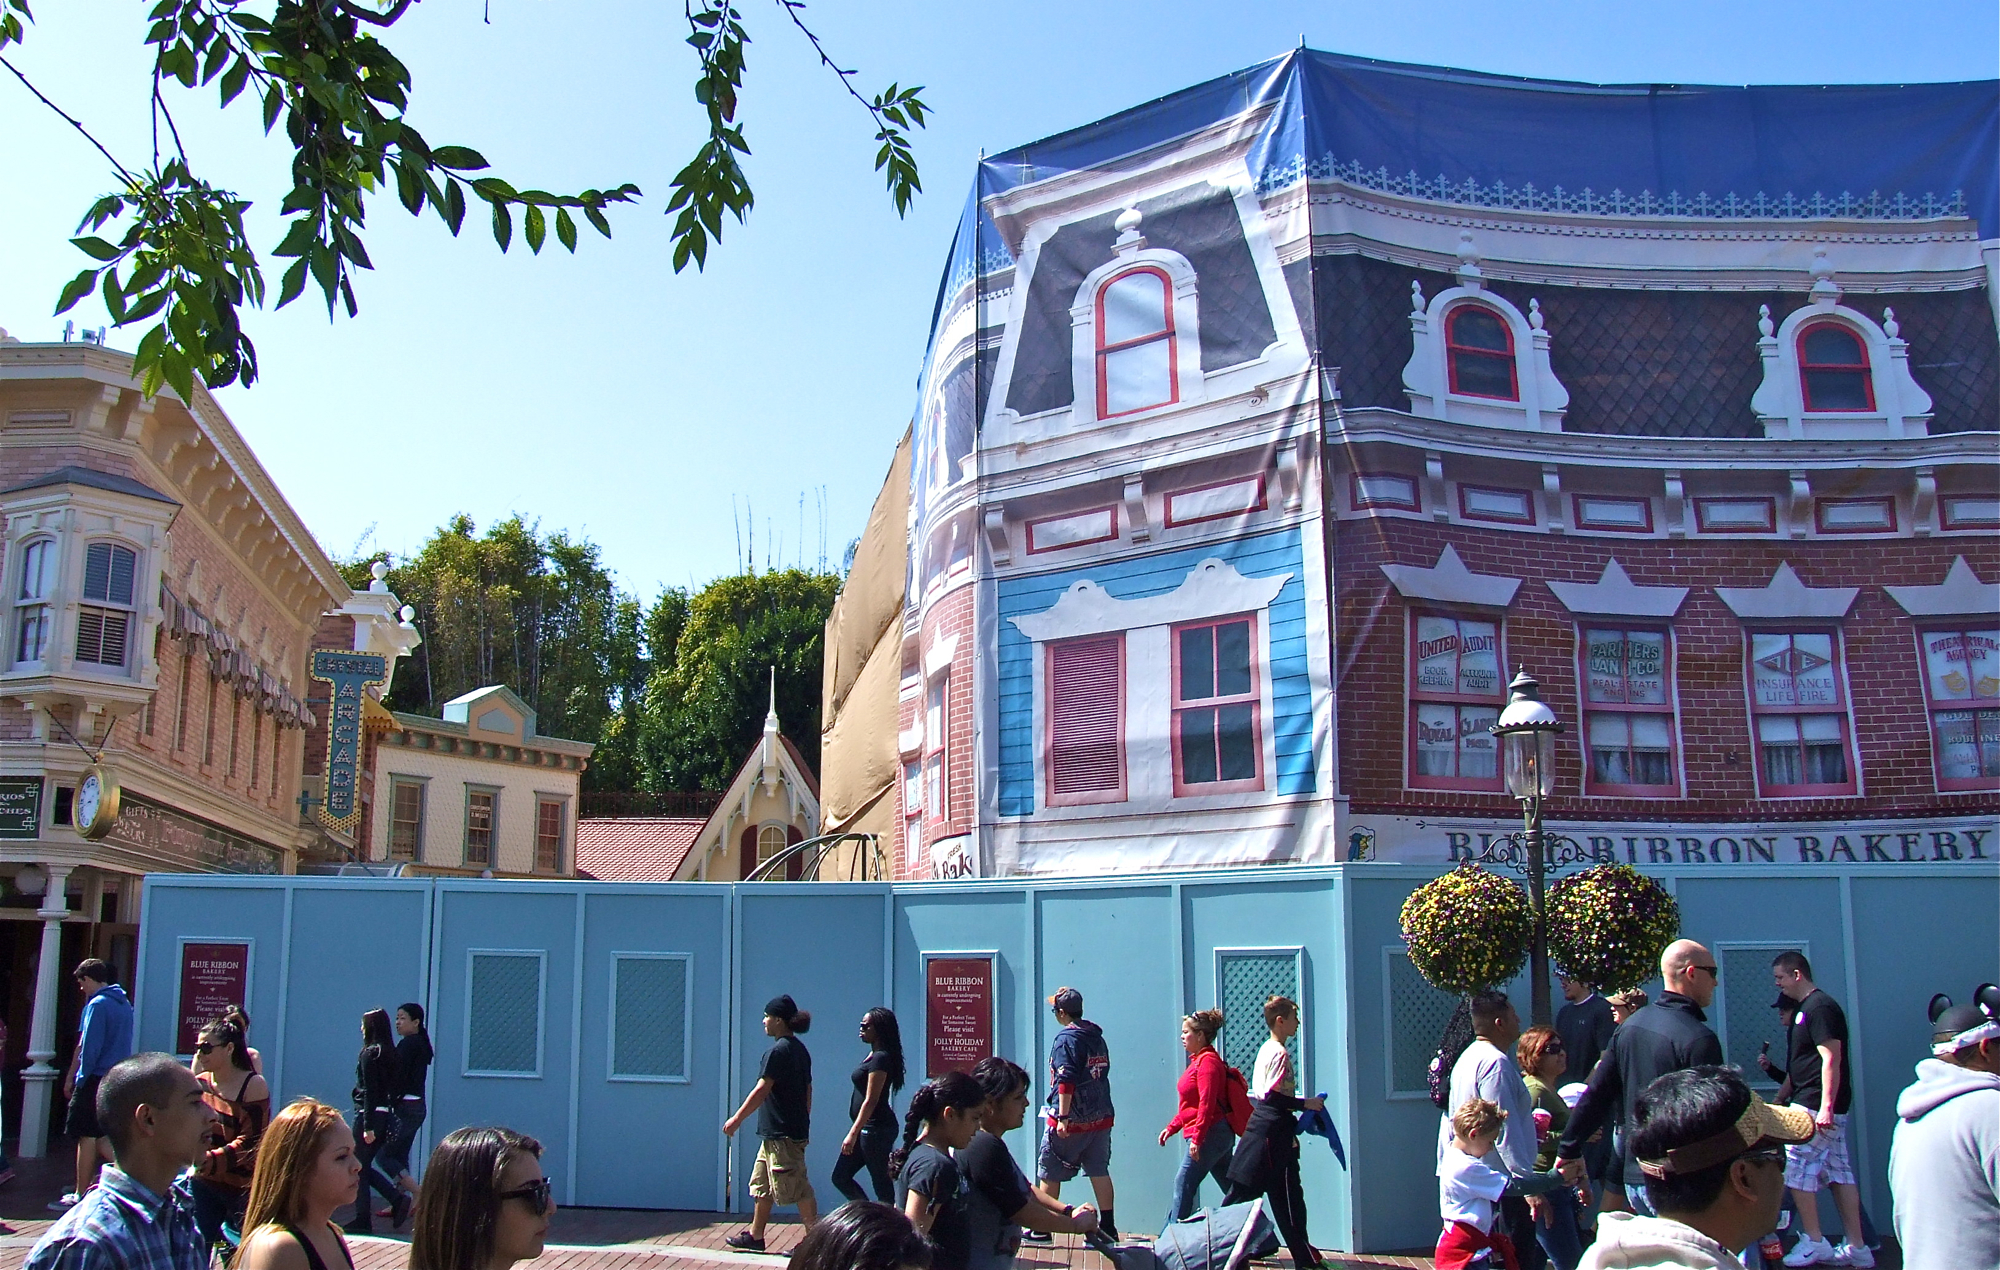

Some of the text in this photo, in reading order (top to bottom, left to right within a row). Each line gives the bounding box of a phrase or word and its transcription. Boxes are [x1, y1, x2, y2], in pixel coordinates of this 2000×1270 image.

[1418, 634, 1494, 660] UNITED AUDIT
[1591, 640, 1659, 660] FARMERS
[317, 657, 383, 676] CRYSTAL
[1425, 666, 1447, 676] BOOK
[1418, 675, 1453, 686] KEEPING
[1757, 678, 1832, 690] INSURANCE
[1766, 690, 1828, 702] LIFE FIRE
[331, 680, 358, 810] ARCADE
[125, 806, 148, 819] GIFTS
[1587, 836, 1778, 863] RIBBON
[1794, 830, 1992, 863] BAKERY
[190, 960, 239, 969] BLUE RIBBON
[935, 977, 984, 985] BLUE RIBBON
[943, 1025, 975, 1033] Please visit
[934, 1038, 985, 1046] JOLLY HOLIDAY
